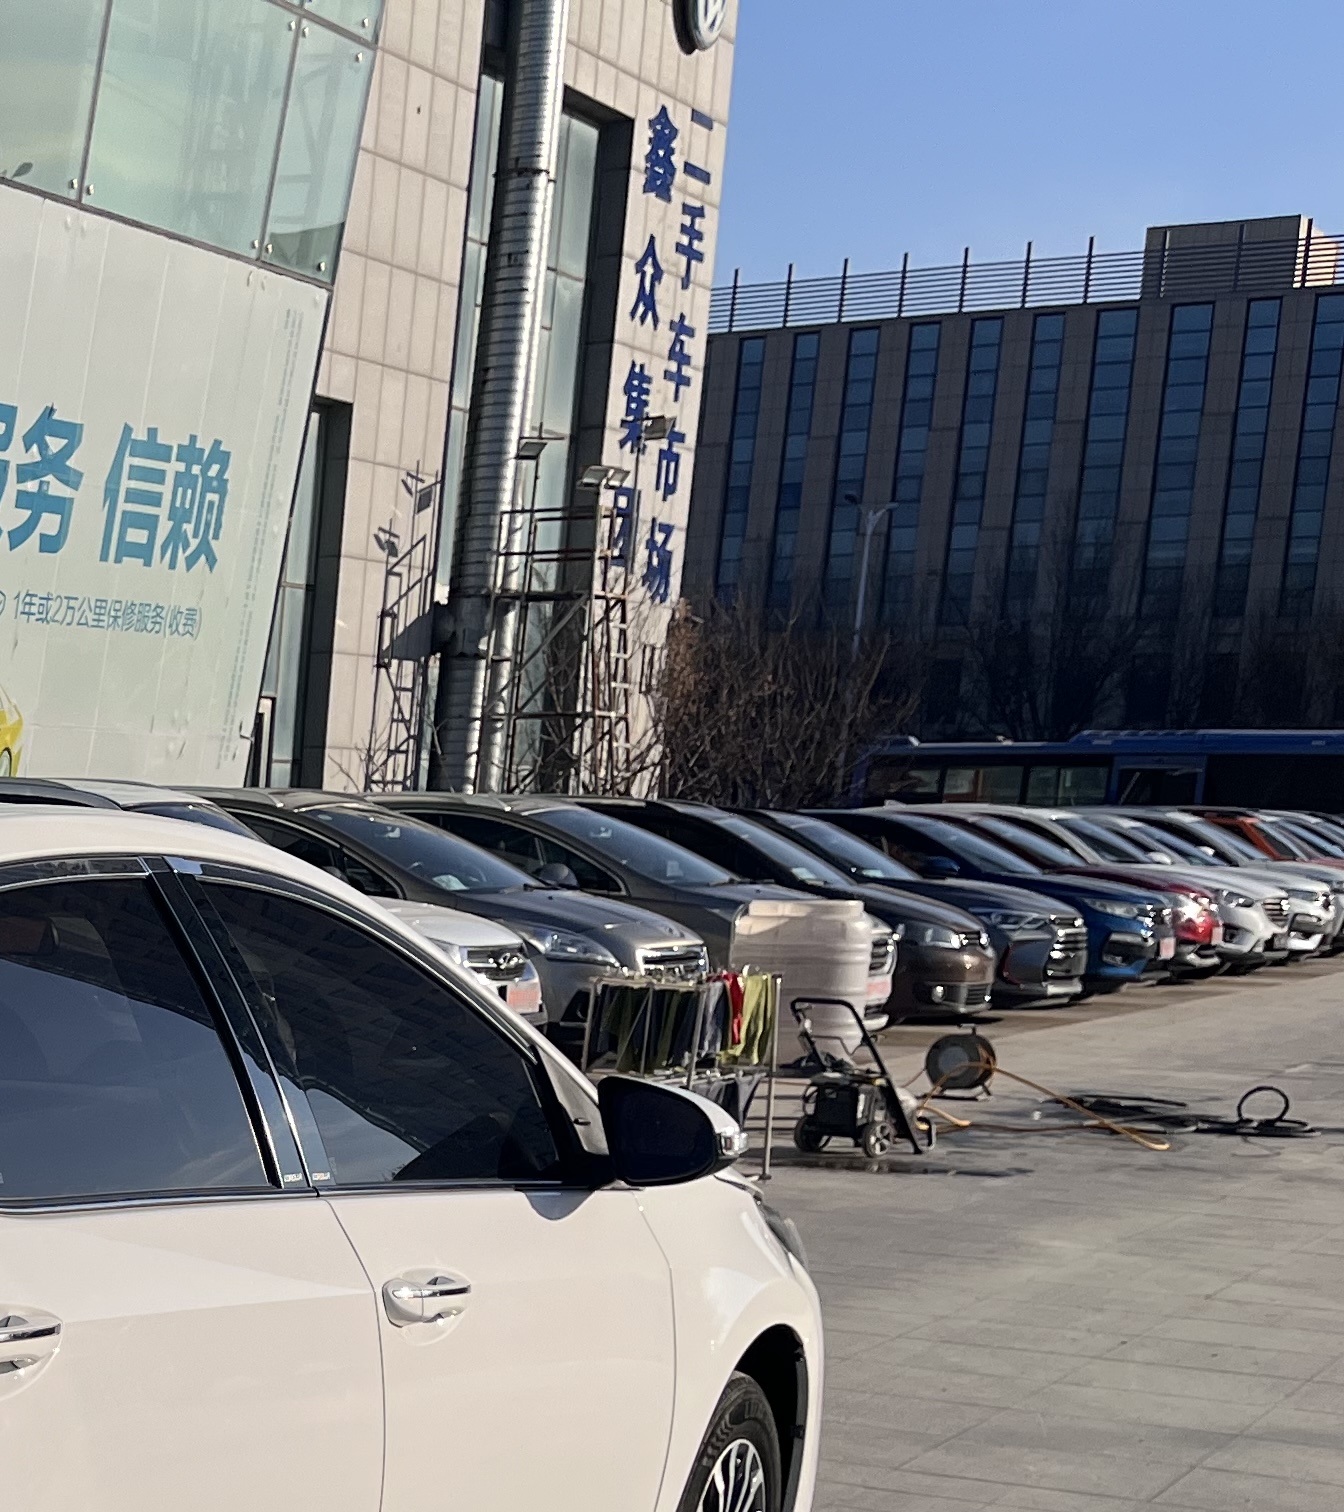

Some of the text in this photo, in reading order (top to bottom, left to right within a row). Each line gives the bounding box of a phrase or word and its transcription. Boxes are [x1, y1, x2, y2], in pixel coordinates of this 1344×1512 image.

[98, 421, 233, 574] 信赖
[641, 107, 714, 604] 二手车市场
